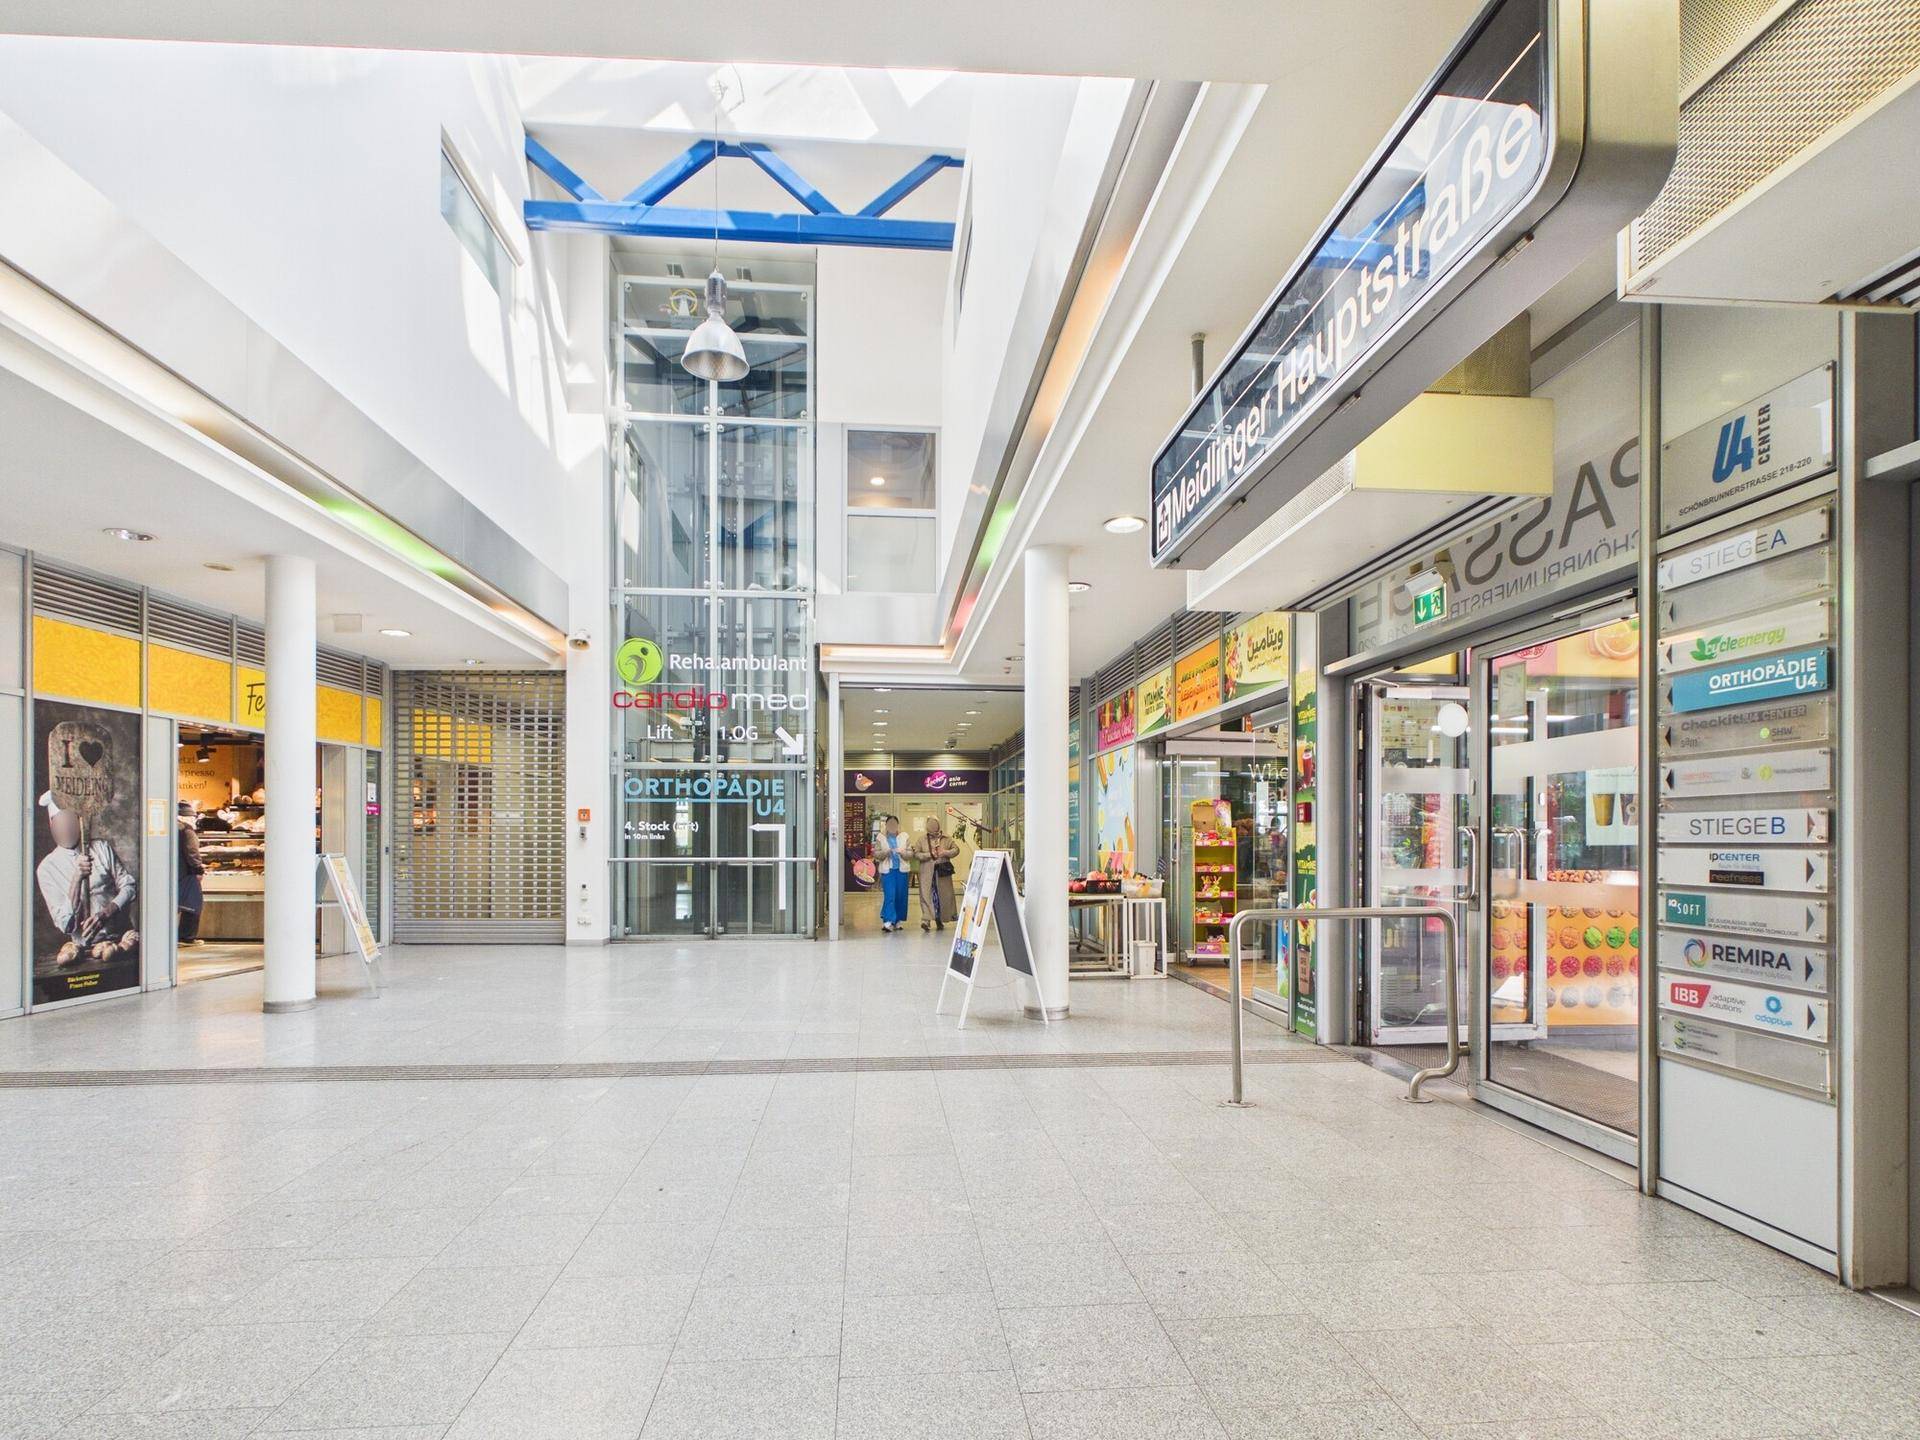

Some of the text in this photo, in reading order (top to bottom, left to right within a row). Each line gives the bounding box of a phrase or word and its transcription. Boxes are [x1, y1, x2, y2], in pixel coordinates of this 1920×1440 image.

[1171, 103, 1533, 530] Meidlinger Hauptstraße
[1712, 403, 1771, 484] U4 CENTER
[1679, 457, 1812, 517] SCHÖNBRUNNERSTRASSE 218-220
[669, 653, 808, 672] Reha.ambulant
[1709, 656, 1818, 690] ORTHOPÄDIE
[1795, 673, 1819, 690] U4
[612, 688, 810, 710] cardiomed
[646, 724, 674, 741] Lift
[624, 773, 786, 797] ORTHOPÄDIE
[756, 799, 786, 817] U4
[624, 820, 636, 831] 4.
[638, 820, 670, 832] Stock
[1712, 944, 1792, 971] REMIRA
[1674, 986, 1699, 1004] IBB
